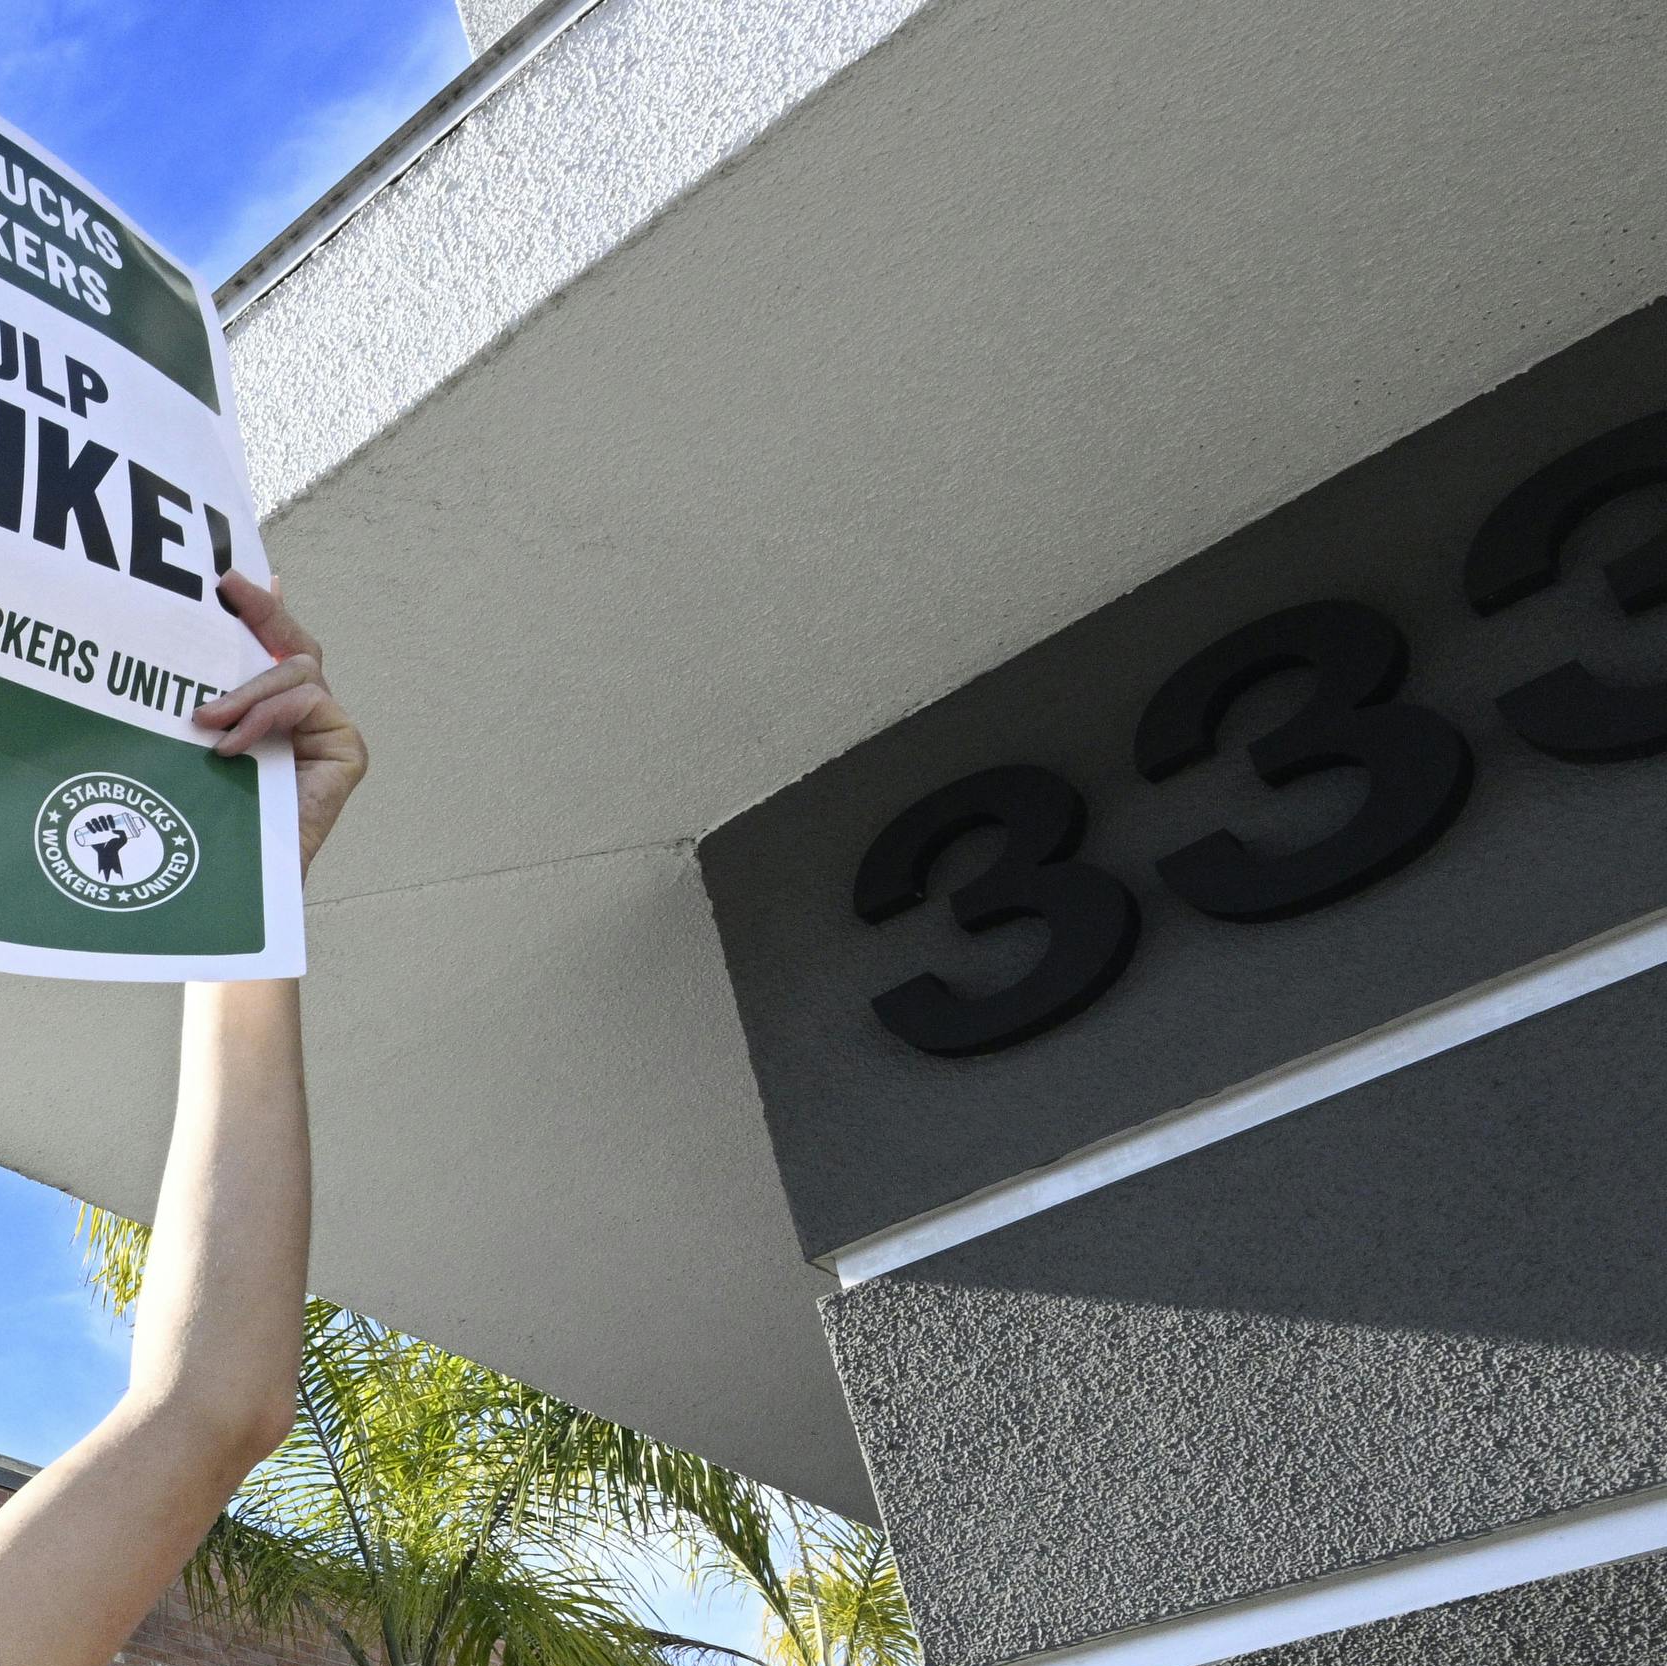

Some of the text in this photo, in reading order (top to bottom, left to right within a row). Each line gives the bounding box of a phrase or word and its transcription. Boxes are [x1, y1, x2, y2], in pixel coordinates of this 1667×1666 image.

[106, 651, 230, 722] UNITE
[62, 781, 177, 832] STARBUCKS
[42, 829, 189, 901] WORKERS UNITED
